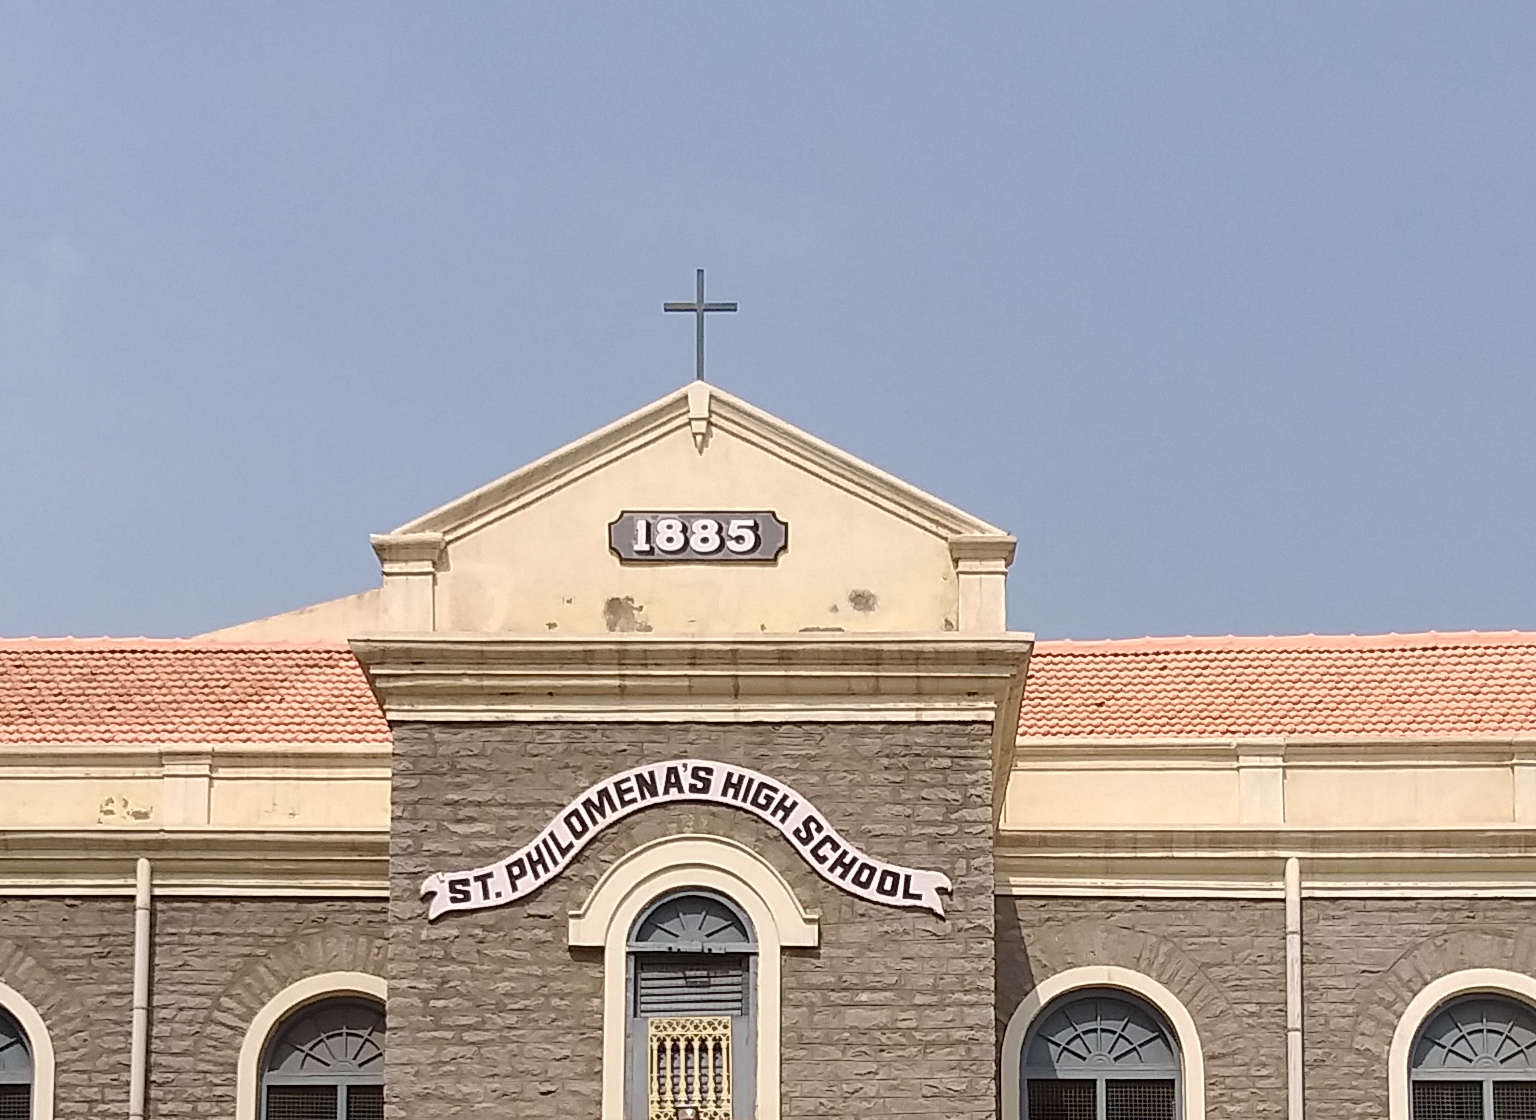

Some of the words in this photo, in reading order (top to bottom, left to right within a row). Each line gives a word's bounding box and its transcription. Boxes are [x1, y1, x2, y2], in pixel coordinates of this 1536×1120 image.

[633, 518, 761, 555] 1885
[448, 871, 502, 904] ST.
[505, 763, 713, 893] PHILOMENA'S
[720, 771, 798, 824] HIGH
[793, 815, 923, 900] SCHOOL
